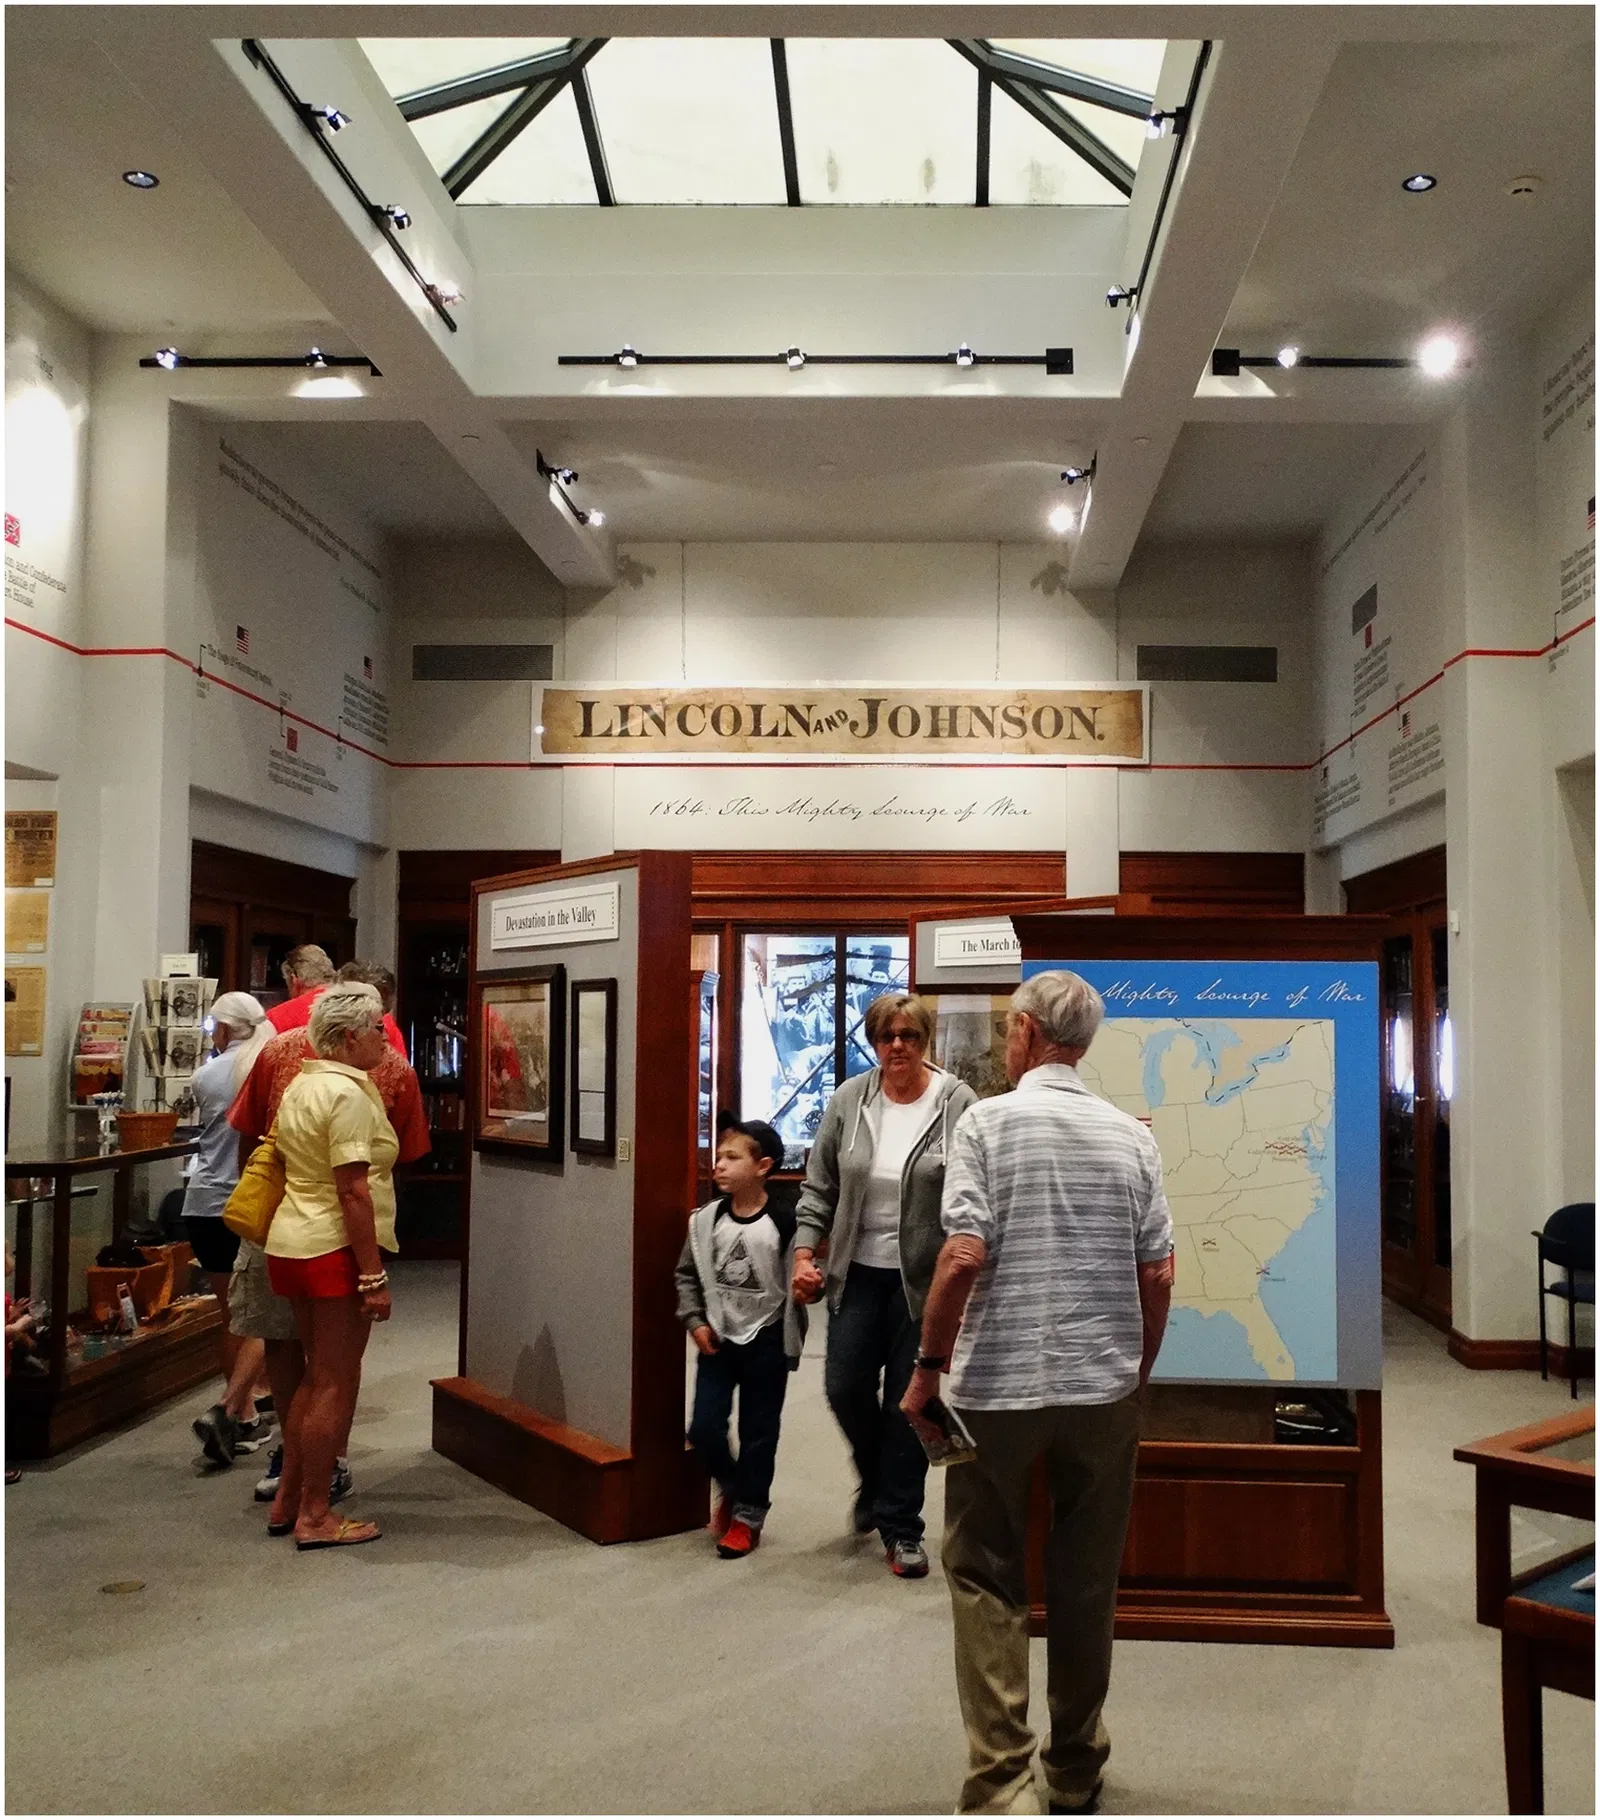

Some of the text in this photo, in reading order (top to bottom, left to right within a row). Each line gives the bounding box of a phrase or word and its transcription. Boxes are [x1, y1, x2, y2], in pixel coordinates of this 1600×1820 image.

[573, 698, 1105, 741] LINCOLN AND JOHNSON.
[649, 796, 1032, 823] 1864: This Mighty Scourge of War
[506, 906, 597, 932] Devastation in the Valley
[961, 938, 1022, 952] The March to
[1099, 978, 1368, 1008] Mighty Scourge of War
